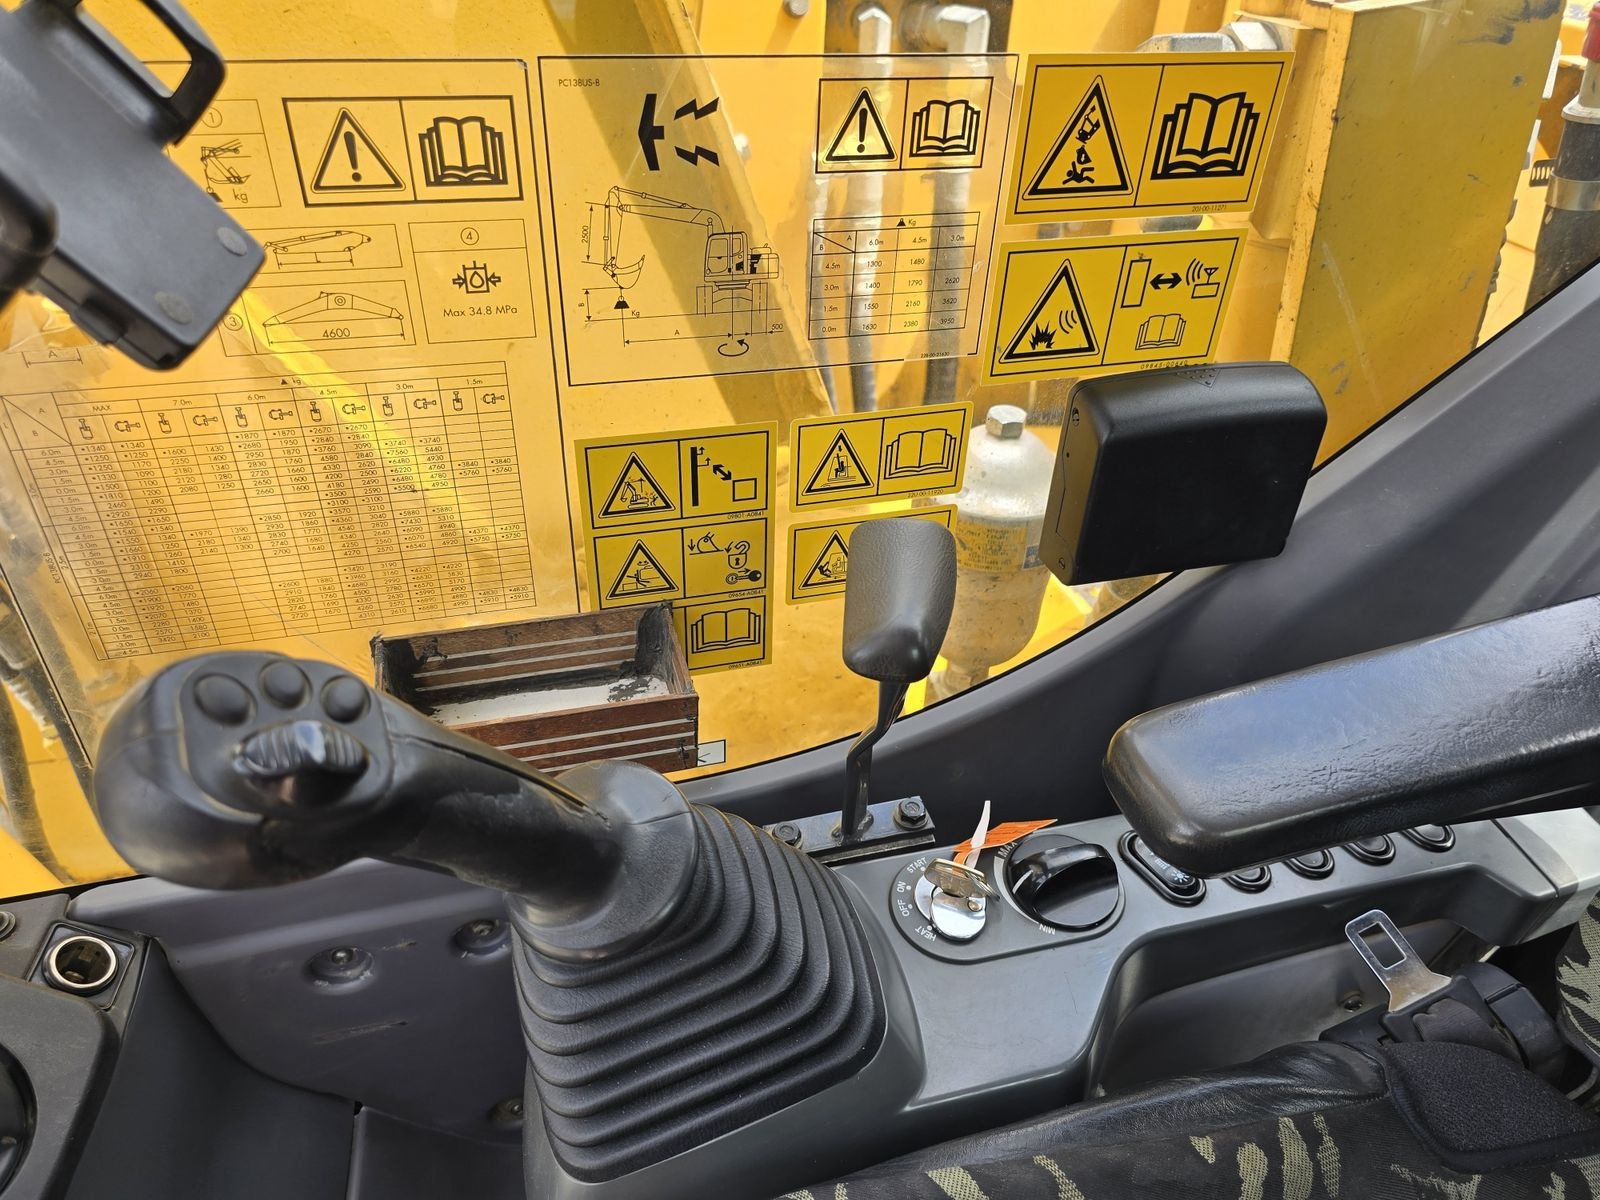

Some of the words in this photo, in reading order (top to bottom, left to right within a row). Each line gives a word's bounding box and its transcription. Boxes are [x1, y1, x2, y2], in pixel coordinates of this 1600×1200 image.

[232, 188, 248, 203] kg
[950, 234, 964, 242] 3.0m
[942, 297, 957, 305] 3620
[443, 308, 466, 318] Max
[468, 306, 492, 316] 34.8
[496, 304, 518, 314] MPa
[632, 310, 640, 318] Kg
[322, 328, 350, 338] 4600
[48, 350, 58, 358] A
[906, 856, 928, 874] START
[896, 881, 906, 892] ON
[898, 899, 910, 916] OFF
[915, 926, 937, 942] HEAT
[1040, 924, 1056, 935] MIN
